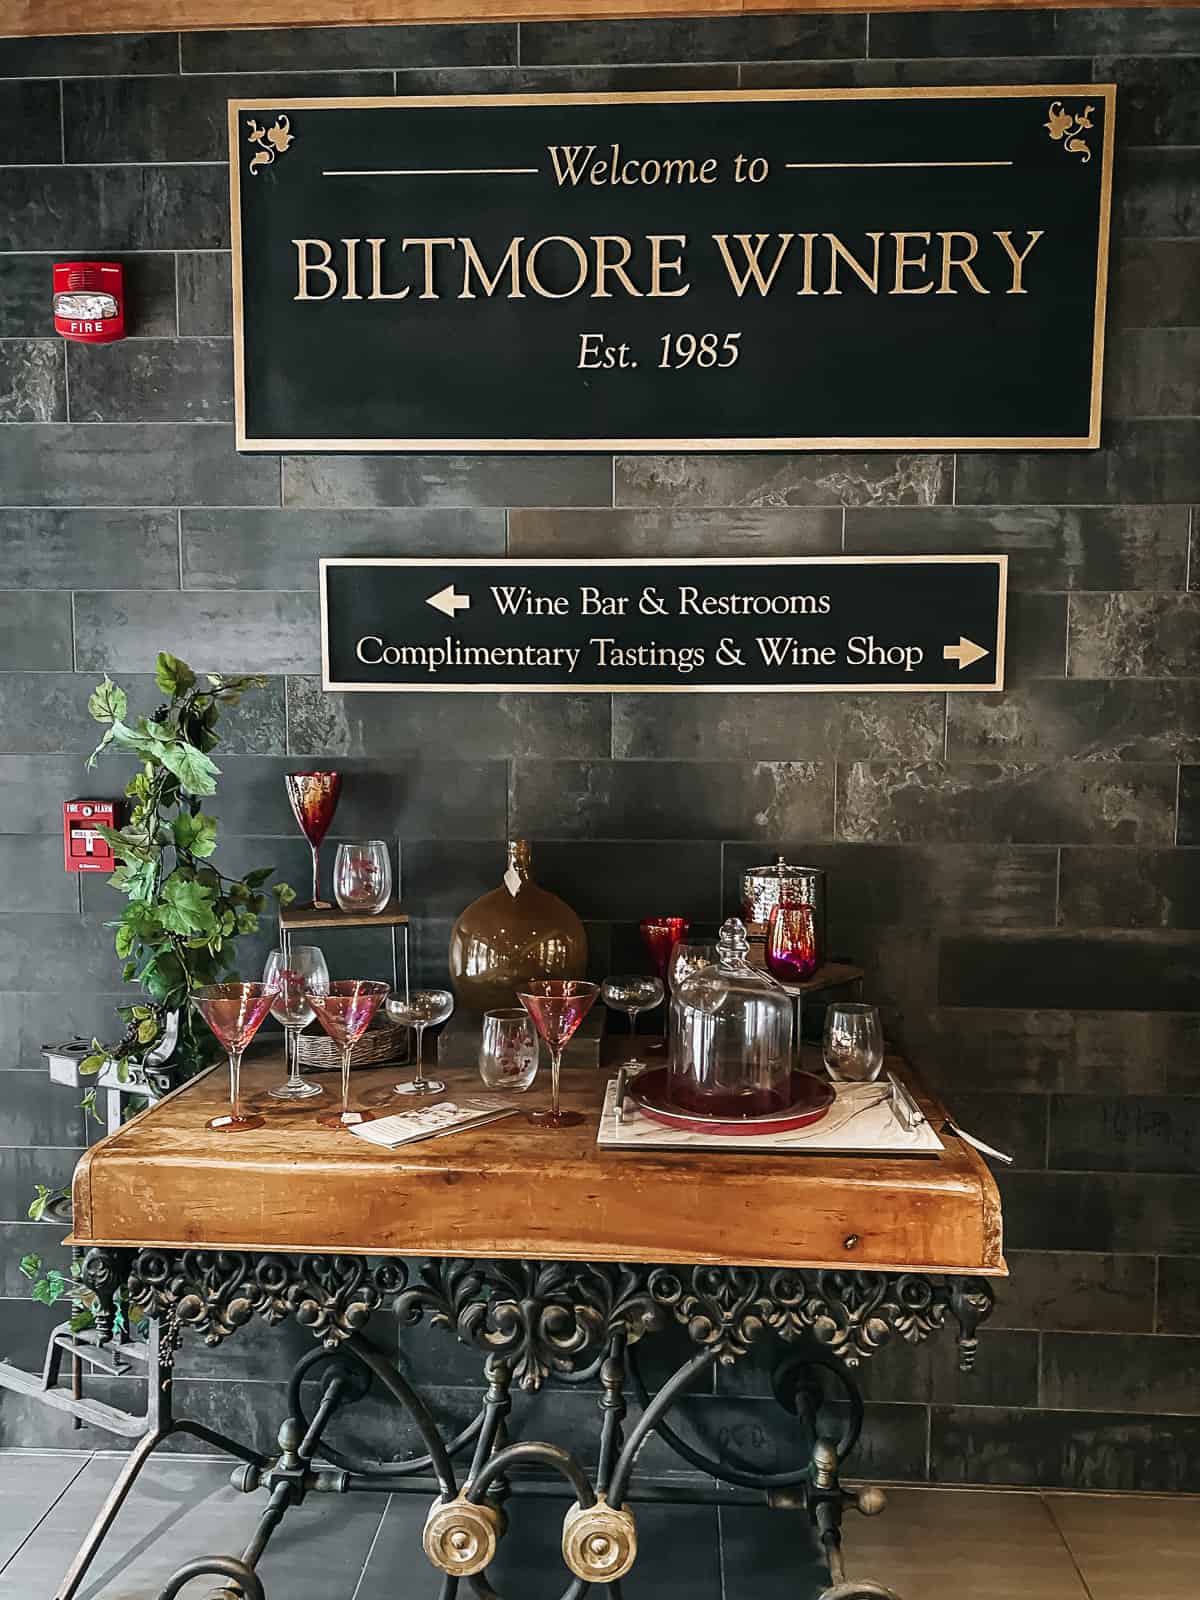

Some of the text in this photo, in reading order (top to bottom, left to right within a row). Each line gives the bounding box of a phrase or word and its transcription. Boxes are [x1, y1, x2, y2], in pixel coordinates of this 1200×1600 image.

[547, 143, 769, 187] Welcome to
[291, 230, 1045, 302] BILTMORE WINERY
[70, 321, 103, 333] FIRE
[576, 332, 742, 369] Est. 1985
[489, 586, 832, 616] Wine Bar & Restrooms
[356, 635, 924, 673] Complimentary Tastings & Wine Shop
